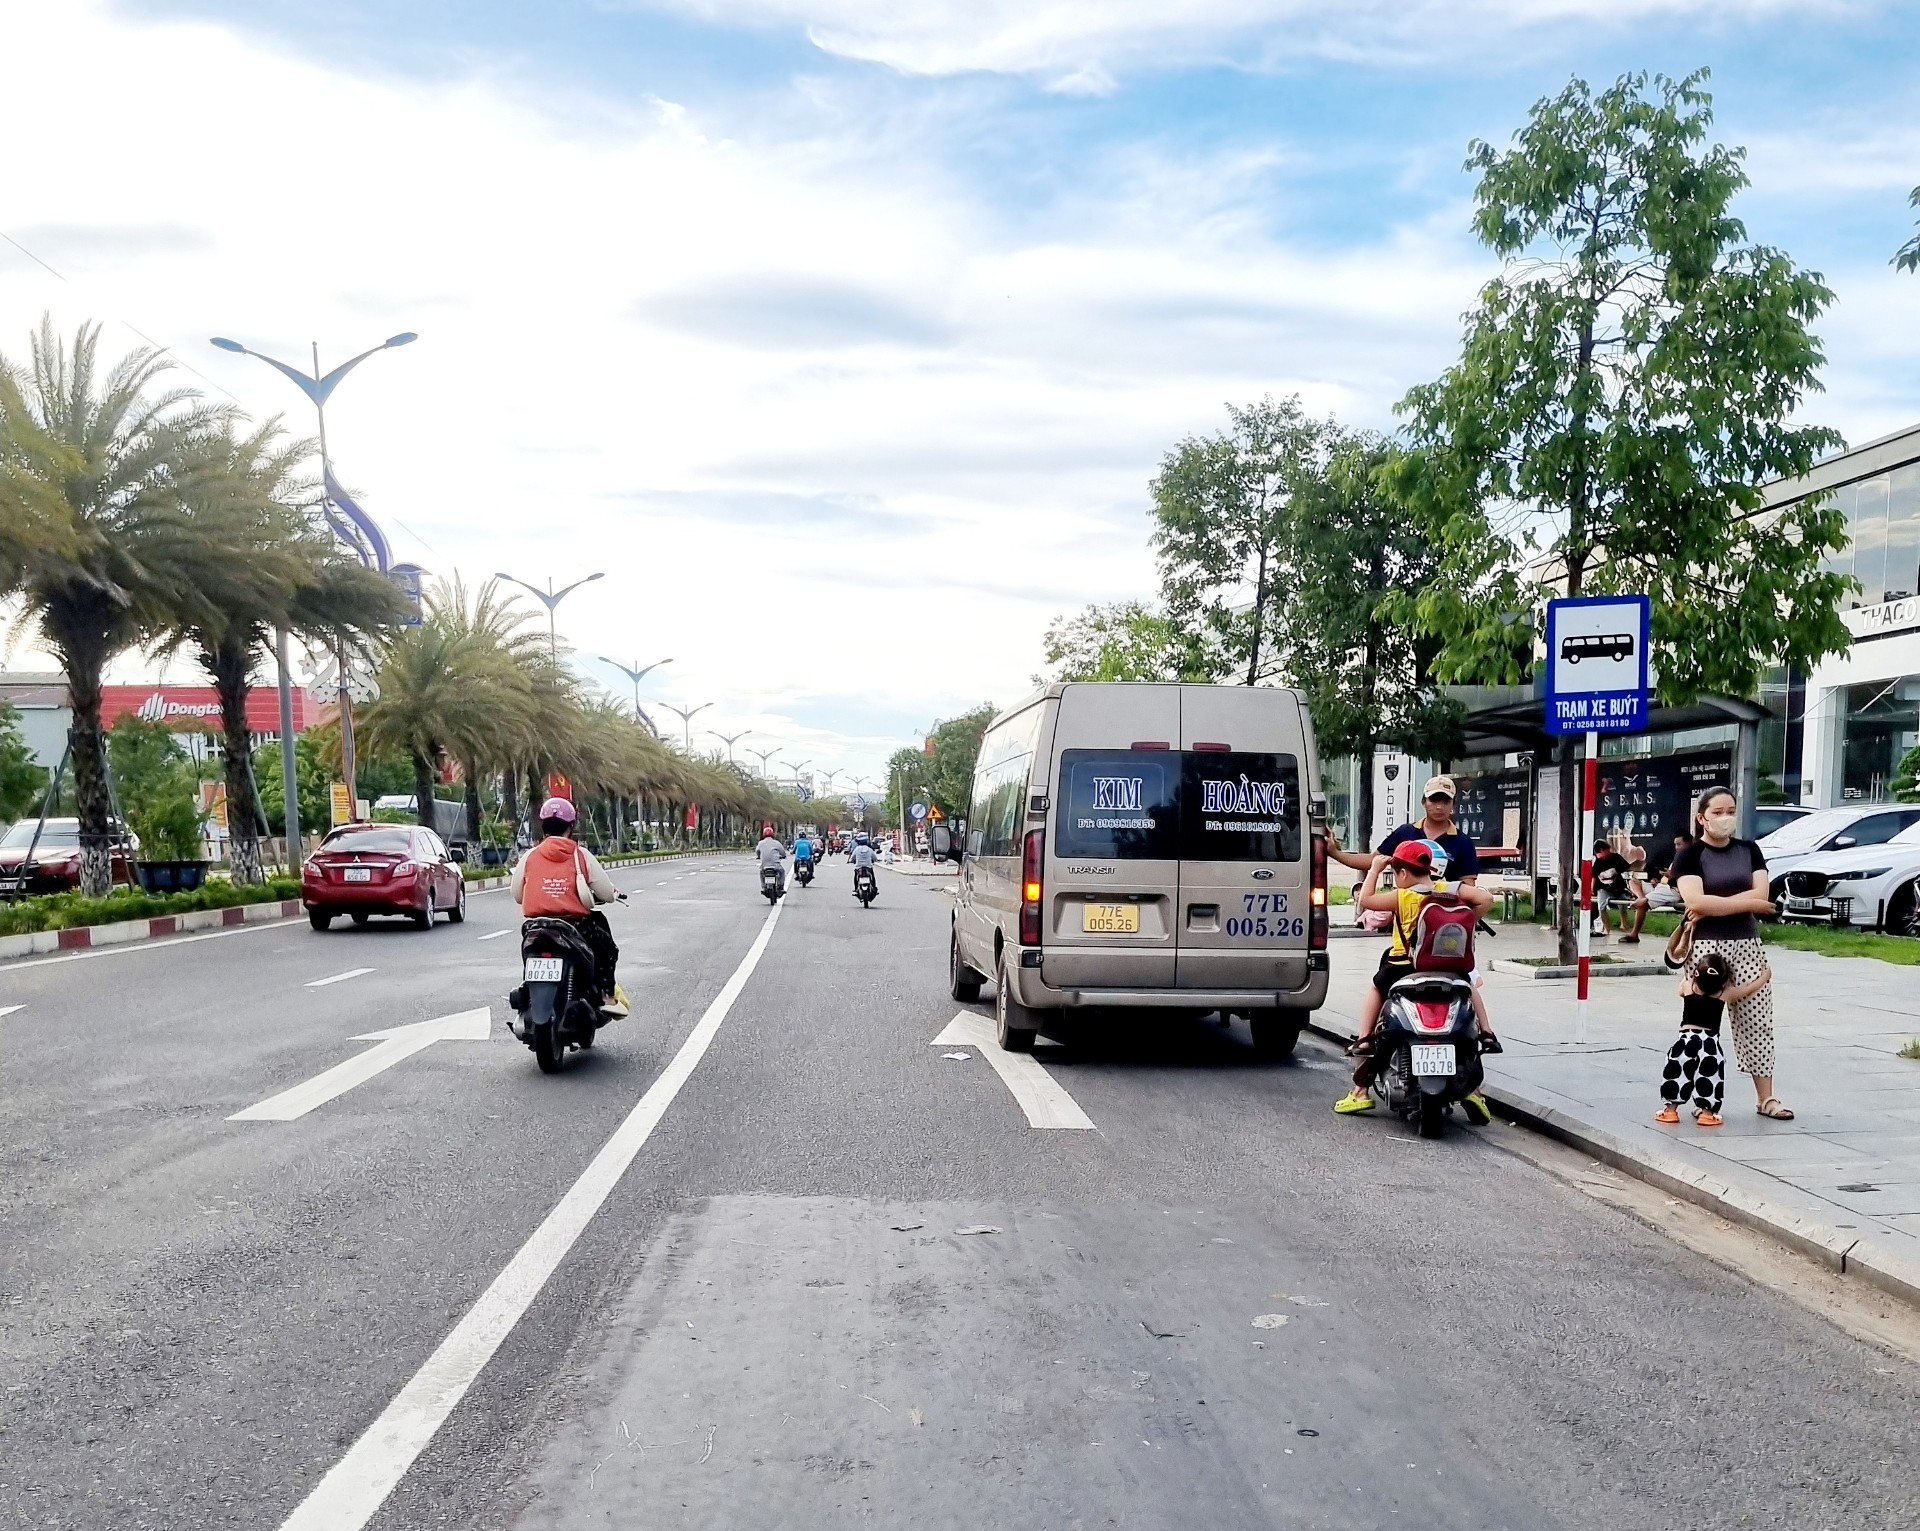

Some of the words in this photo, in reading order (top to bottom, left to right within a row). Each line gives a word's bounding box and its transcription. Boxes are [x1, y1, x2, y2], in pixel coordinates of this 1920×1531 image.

[1861, 598, 1917, 630] THACO
[1555, 700, 1588, 720] TRẠM
[1591, 699, 1607, 717] XE
[1610, 694, 1639, 715] BUÝT
[1562, 721, 1575, 729] ĐT:
[1576, 720, 1595, 729] 0256
[1093, 777, 1142, 810] KIM
[1202, 773, 1285, 815] HOÀNG
[1386, 785, 1395, 838] UGEOT
[1067, 866, 1117, 875] TRANSIT
[1243, 893, 1288, 913] 77E
[1099, 905, 1123, 918] 77E
[1089, 918, 1133, 931] 005.26
[1226, 917, 1304, 937] 005.26
[532, 960, 557, 970] 77-L1
[1418, 1047, 1448, 1060] 77-F1
[1415, 1060, 1453, 1074] 103.78
